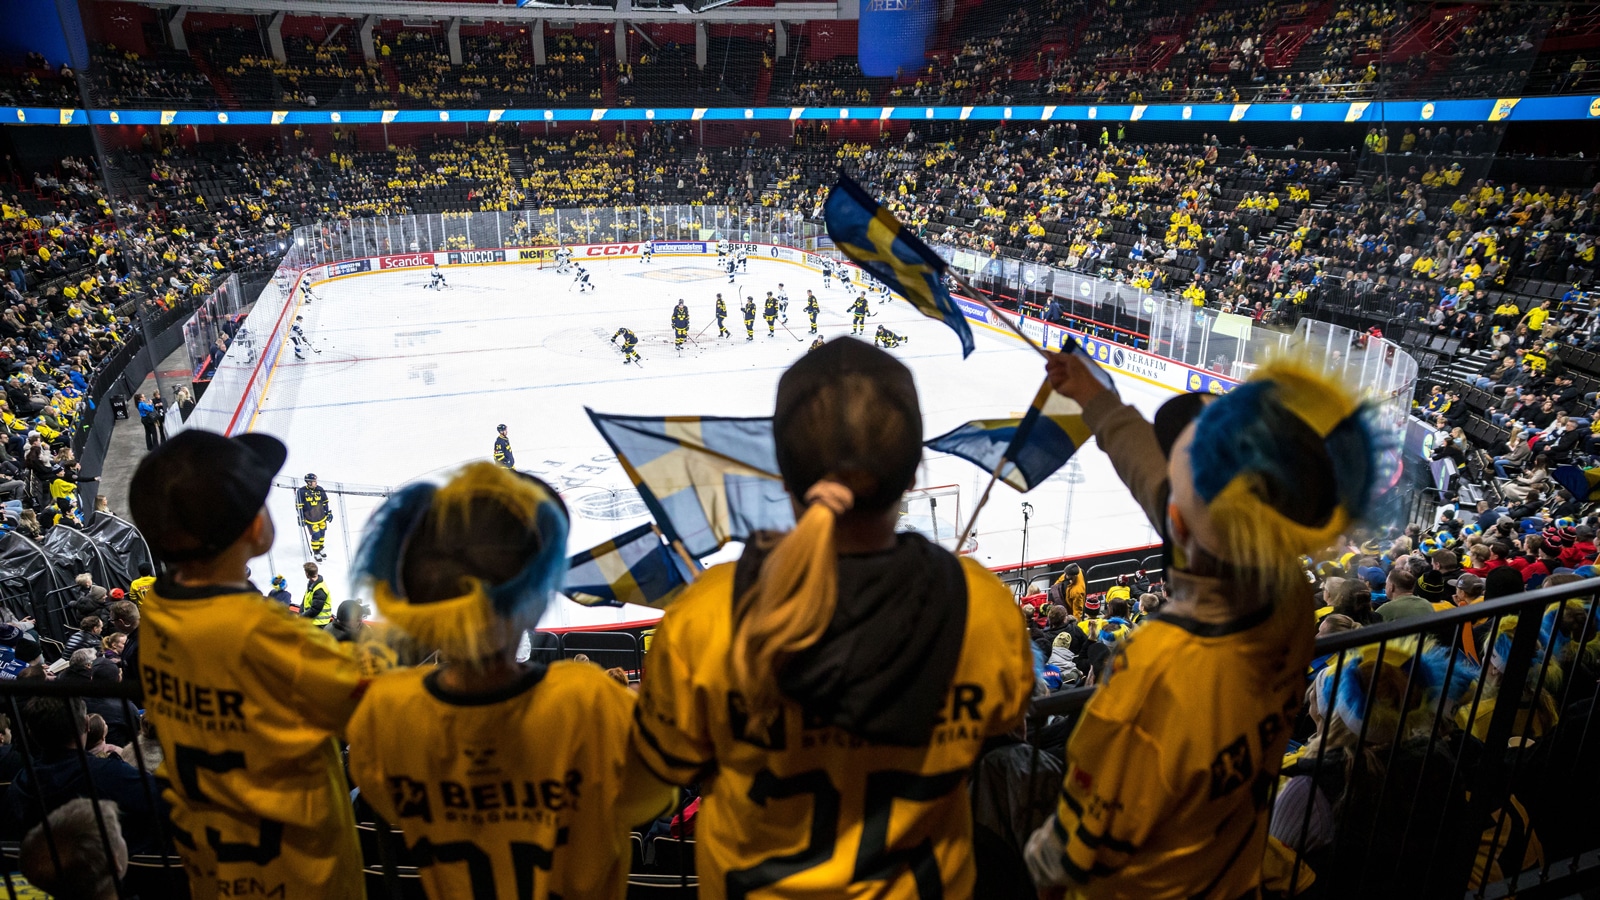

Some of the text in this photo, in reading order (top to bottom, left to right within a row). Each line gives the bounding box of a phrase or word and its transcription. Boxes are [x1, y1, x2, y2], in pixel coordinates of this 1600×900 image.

[461, 251, 494, 264] NOCCO
[587, 245, 640, 257] CCM
[385, 255, 429, 269] Scandic
[1127, 352, 1167, 372] SERAFIM
[1127, 363, 1158, 379] FINANS
[142, 664, 247, 720] BEIJER
[439, 768, 584, 813] BEIJER
